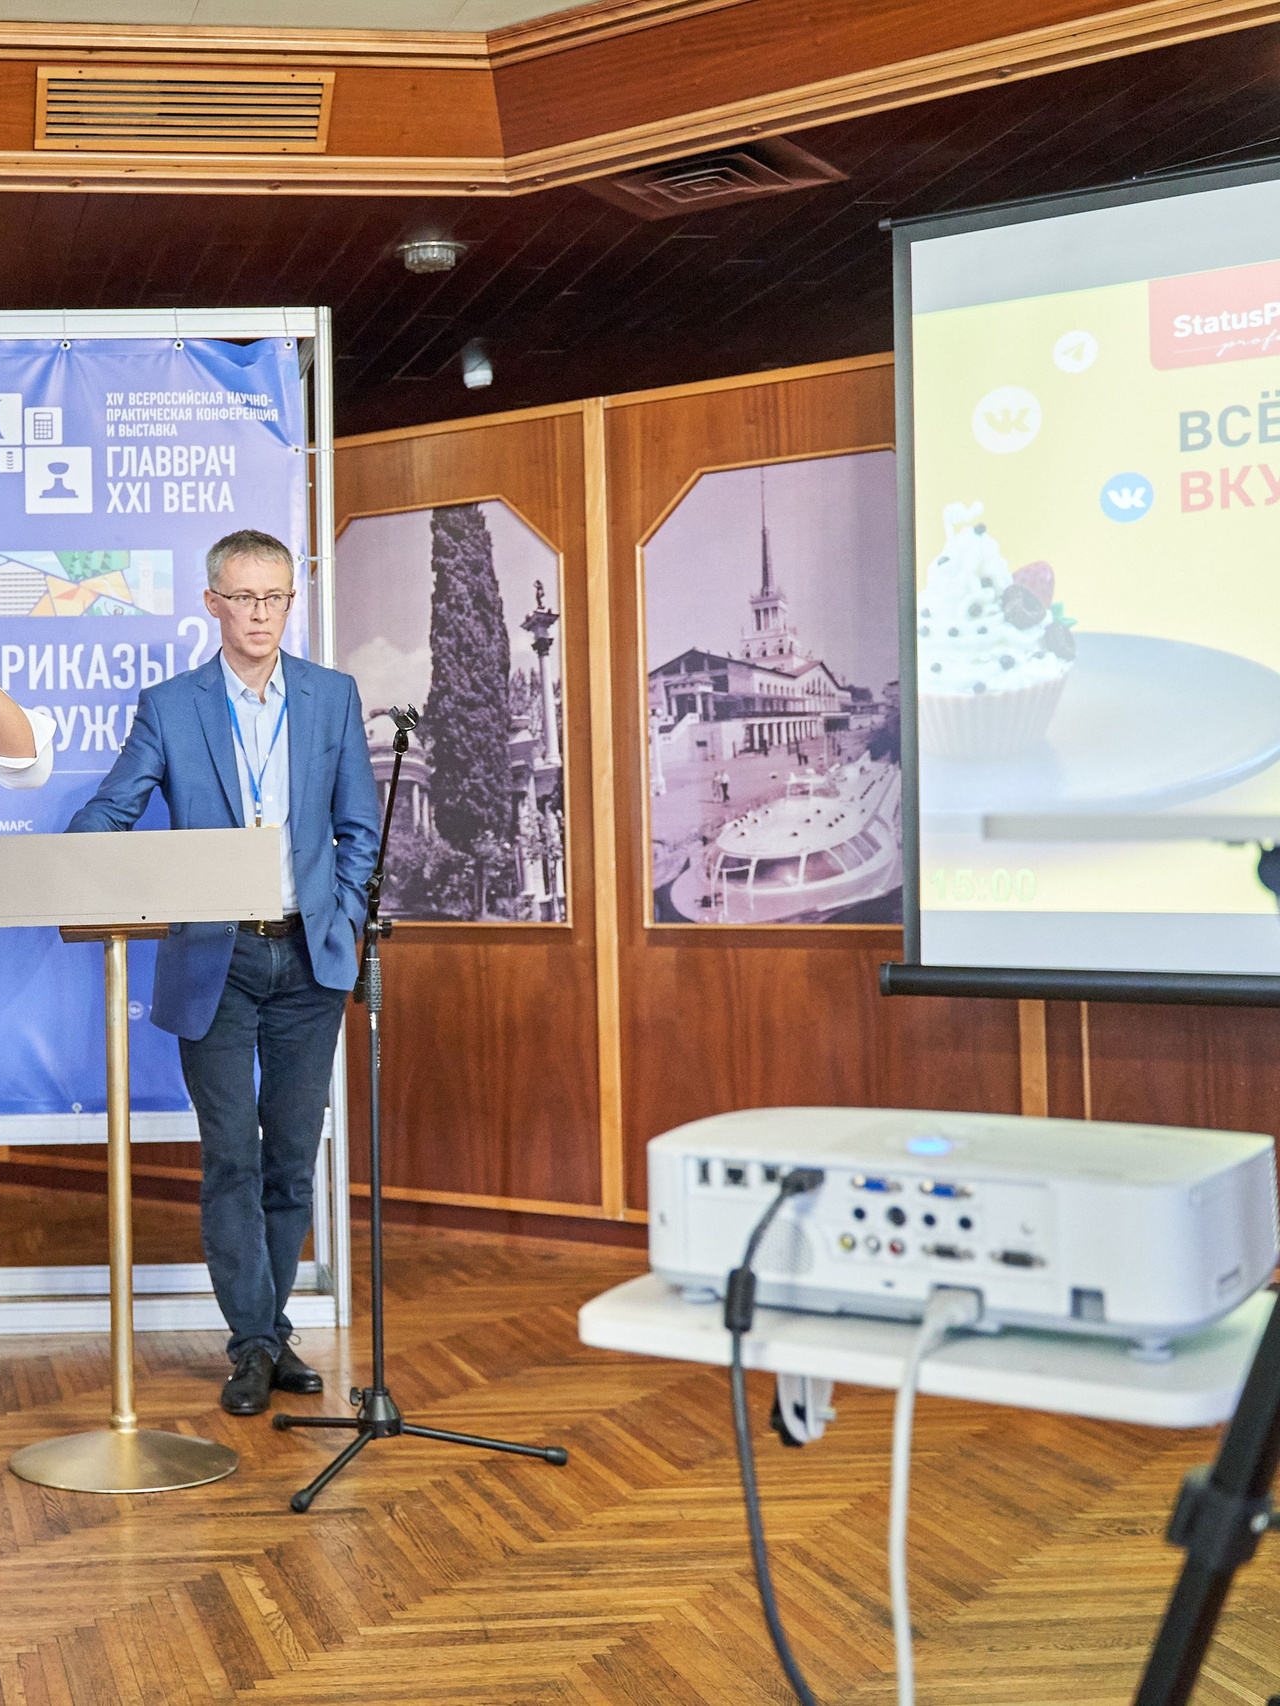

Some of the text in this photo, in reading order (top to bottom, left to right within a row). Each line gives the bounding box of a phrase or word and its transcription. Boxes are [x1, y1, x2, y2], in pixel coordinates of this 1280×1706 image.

[128, 390, 223, 406] ВСЕРОССИЙСКАЯ
[227, 391, 273, 407] НАУЧНО-
[106, 406, 278, 422] ПРАКТИЧЕСКАЯ КОНФЕРЕНЦИЯ
[106, 423, 178, 438] И ВЫСТАВКА
[106, 445, 236, 478] ГЛАВВРАЧ
[106, 481, 235, 514] XXI ВЕКА
[930, 867, 1037, 902] 15:00
